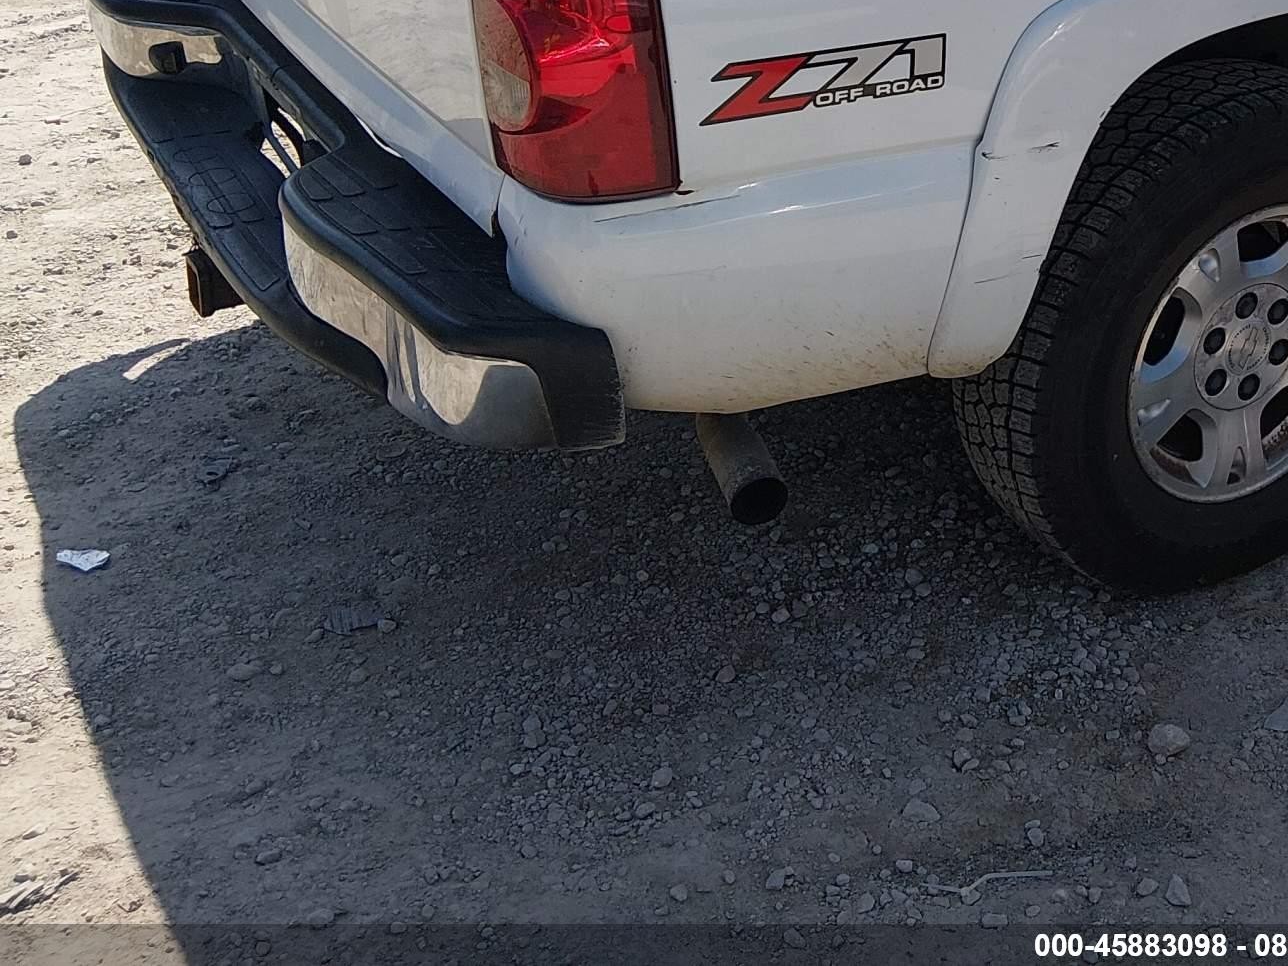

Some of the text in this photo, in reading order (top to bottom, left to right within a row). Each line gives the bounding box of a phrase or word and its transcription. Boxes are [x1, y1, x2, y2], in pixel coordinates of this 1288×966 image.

[699, 33, 946, 126] Z71
[815, 75, 943, 107] OFF ROAD
